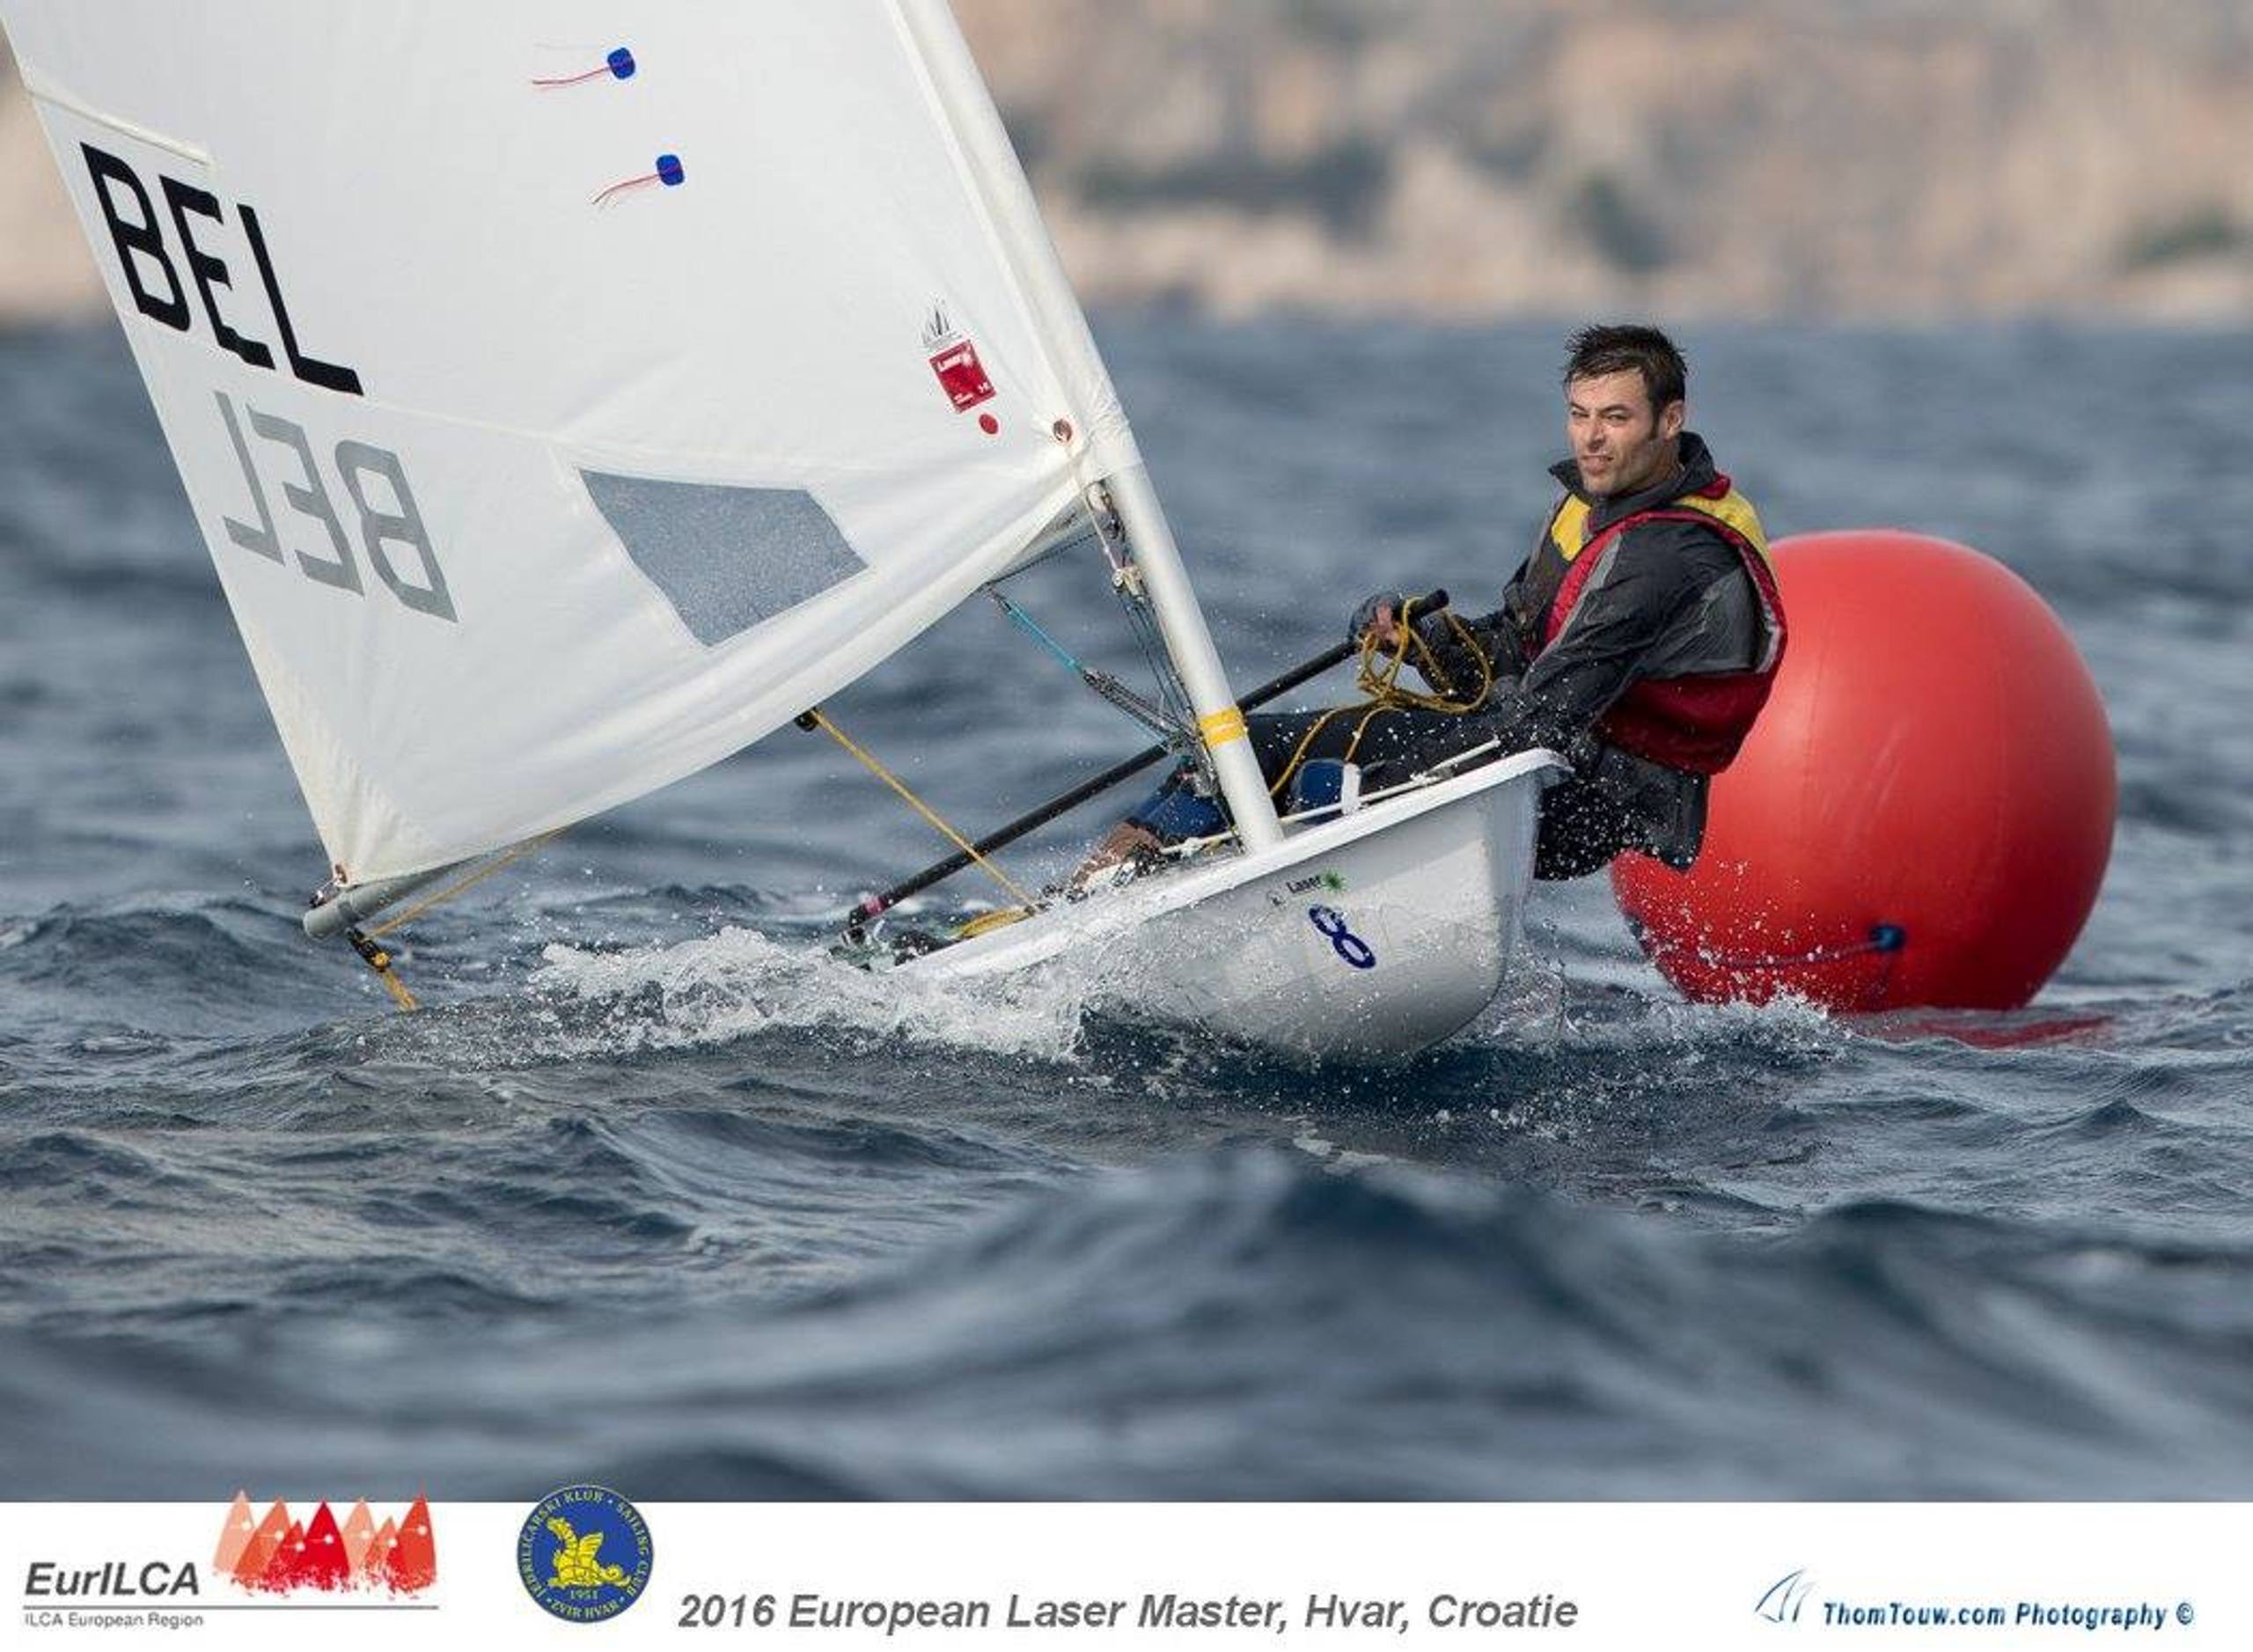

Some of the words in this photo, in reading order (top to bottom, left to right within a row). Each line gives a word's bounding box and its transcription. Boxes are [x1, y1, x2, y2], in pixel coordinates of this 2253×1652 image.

[80, 142, 364, 396] BEL
[1286, 875, 1327, 894] Laser
[1308, 903, 1376, 969] 8
